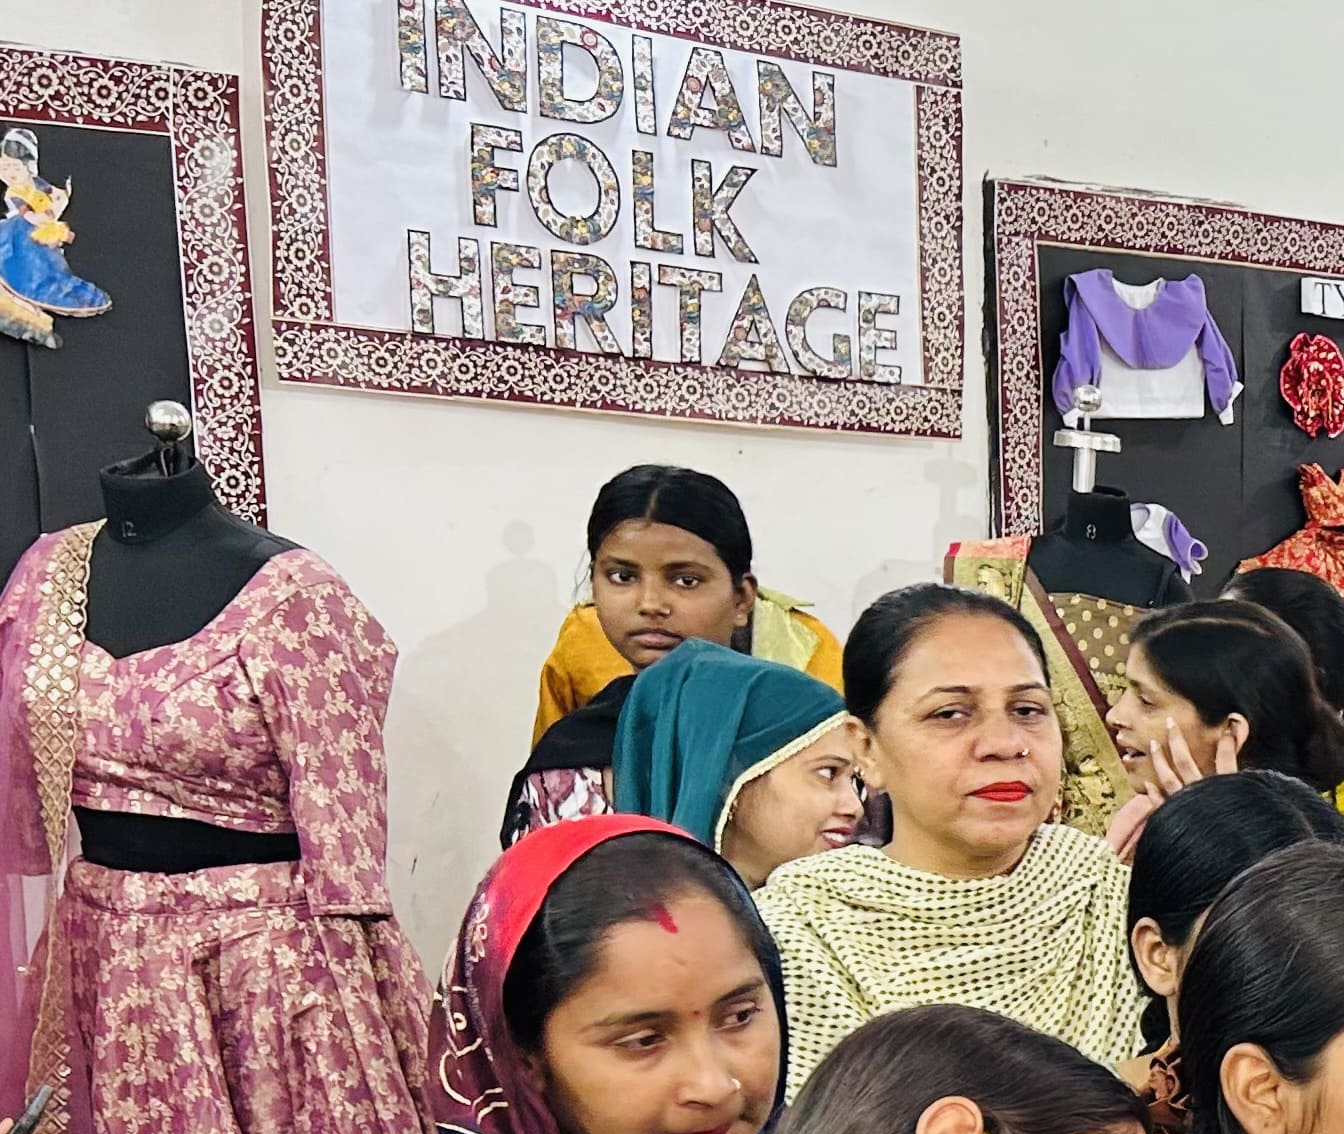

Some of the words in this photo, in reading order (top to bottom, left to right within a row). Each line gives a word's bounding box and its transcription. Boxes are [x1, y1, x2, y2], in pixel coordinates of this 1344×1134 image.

[399, 0, 838, 168] INDIAN
[469, 122, 759, 264] FOLK
[406, 229, 901, 385] HERITAGE
